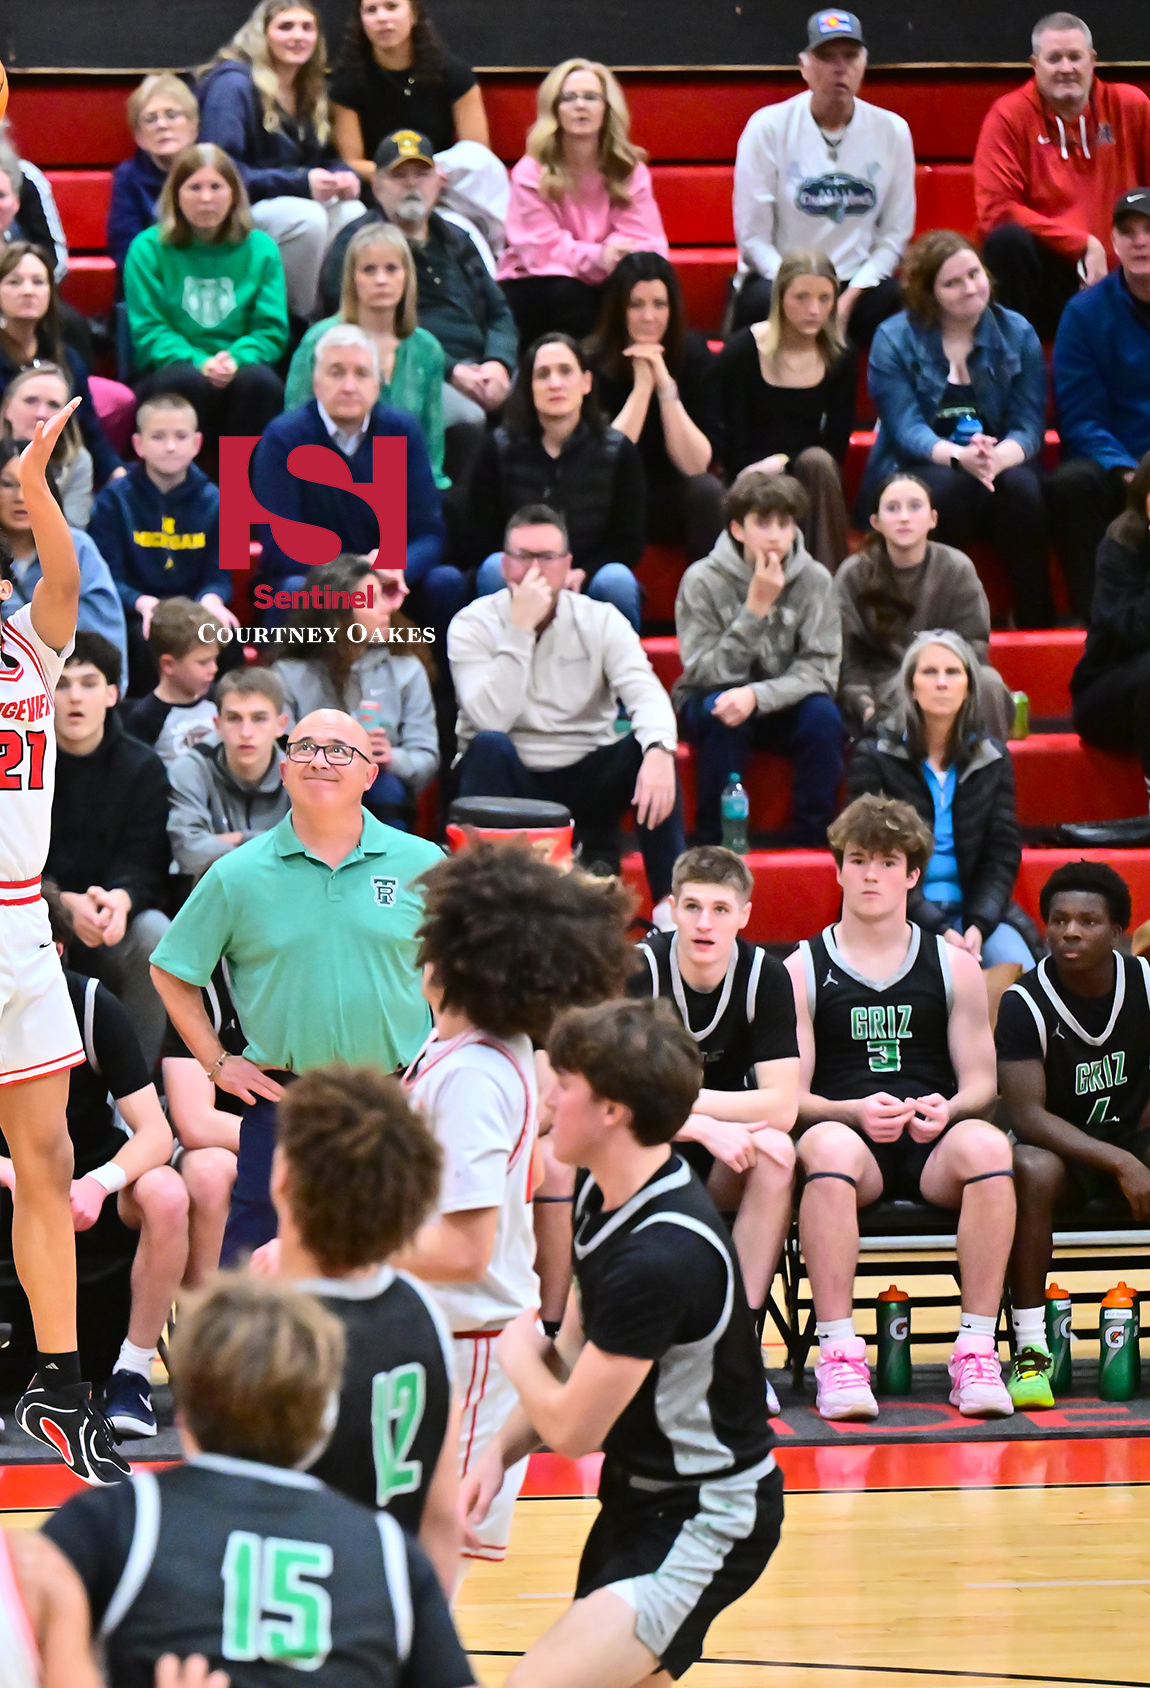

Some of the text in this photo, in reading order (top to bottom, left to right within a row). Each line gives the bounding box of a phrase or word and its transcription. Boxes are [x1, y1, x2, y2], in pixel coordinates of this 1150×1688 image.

[850, 1005, 913, 1040] GRIZ
[867, 1039, 901, 1072] 3
[1075, 1051, 1128, 1096] GRIZ
[371, 1362, 426, 1507] 12
[221, 1530, 334, 1672] 15
